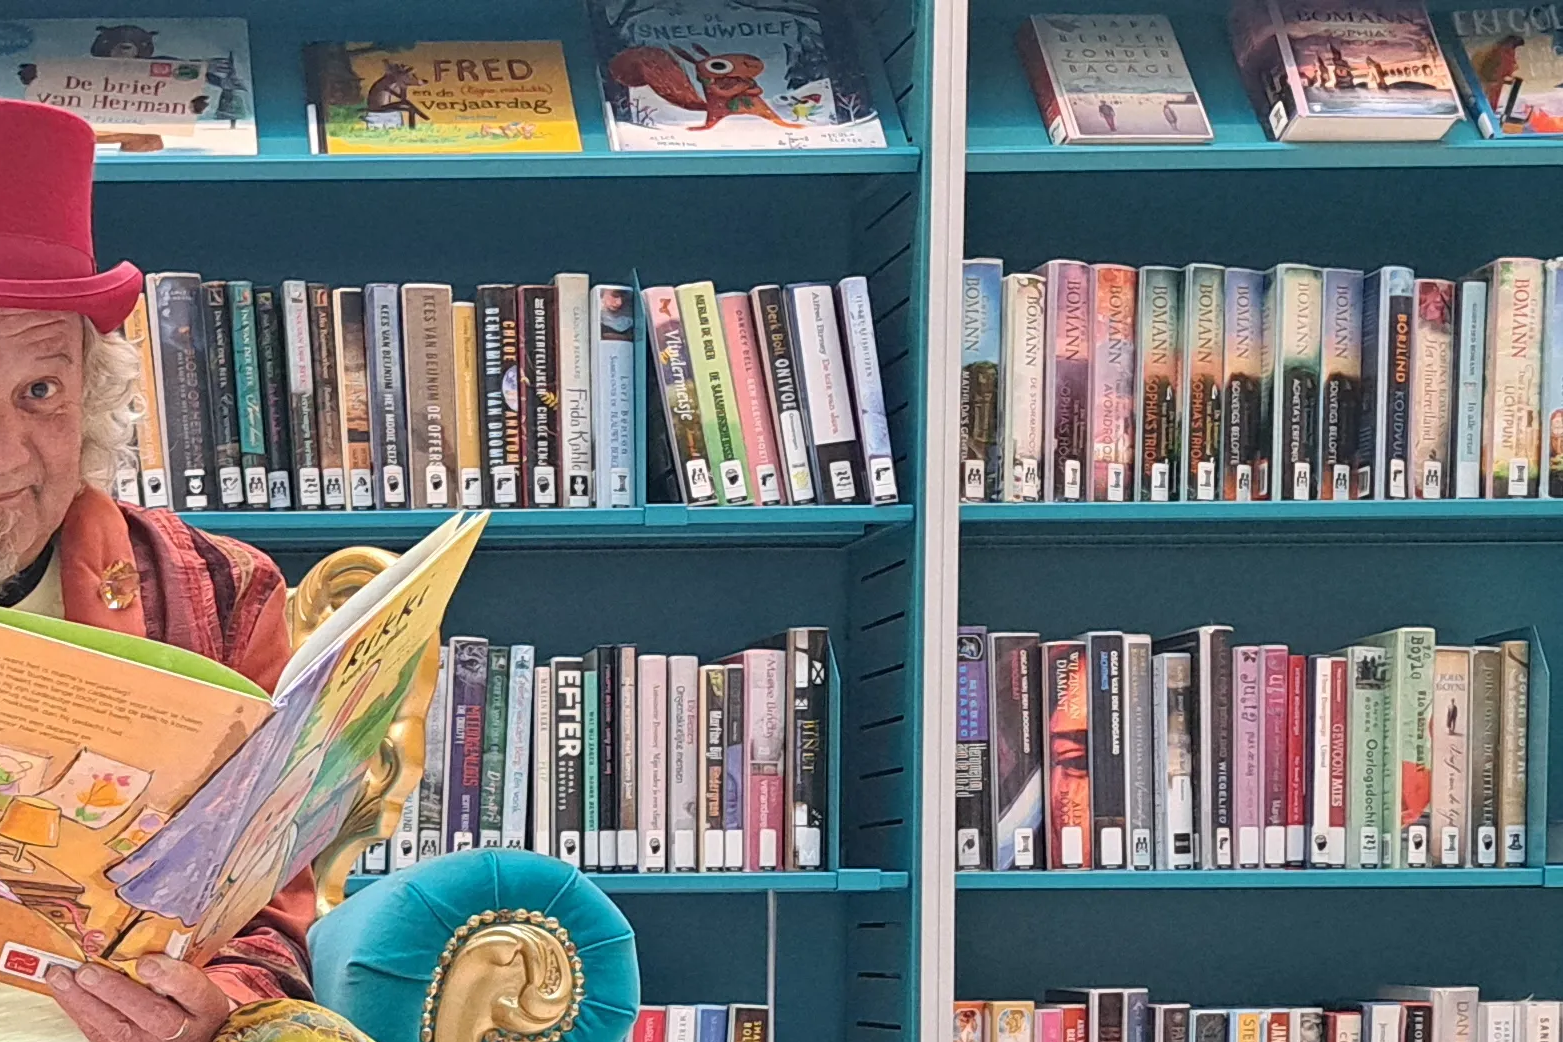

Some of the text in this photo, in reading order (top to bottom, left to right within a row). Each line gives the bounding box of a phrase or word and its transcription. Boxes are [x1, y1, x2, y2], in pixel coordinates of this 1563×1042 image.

[639, 21, 793, 40] SNEEUWDIEF
[65, 75, 166, 97] De brief
[433, 58, 533, 82] FRED
[91, 94, 186, 115] Herman
[381, 330, 393, 348] VAN
[425, 328, 439, 348] VAN
[484, 307, 501, 375] BENJAMIN
[1065, 280, 1082, 361] BOMANN
[1151, 286, 1168, 364] BOMANN
[1196, 283, 1213, 365] BOMANN
[1511, 279, 1530, 358] BOMANN
[663, 329, 694, 421] Vlindermeisje
[427, 406, 440, 421] DE
[566, 388, 588, 428] Frida
[557, 670, 581, 757] EFTER
[1331, 723, 1343, 807] GEWOON MIES
[1218, 762, 1228, 824] WIEGELIED
[1455, 1001, 1469, 1037] DAN
